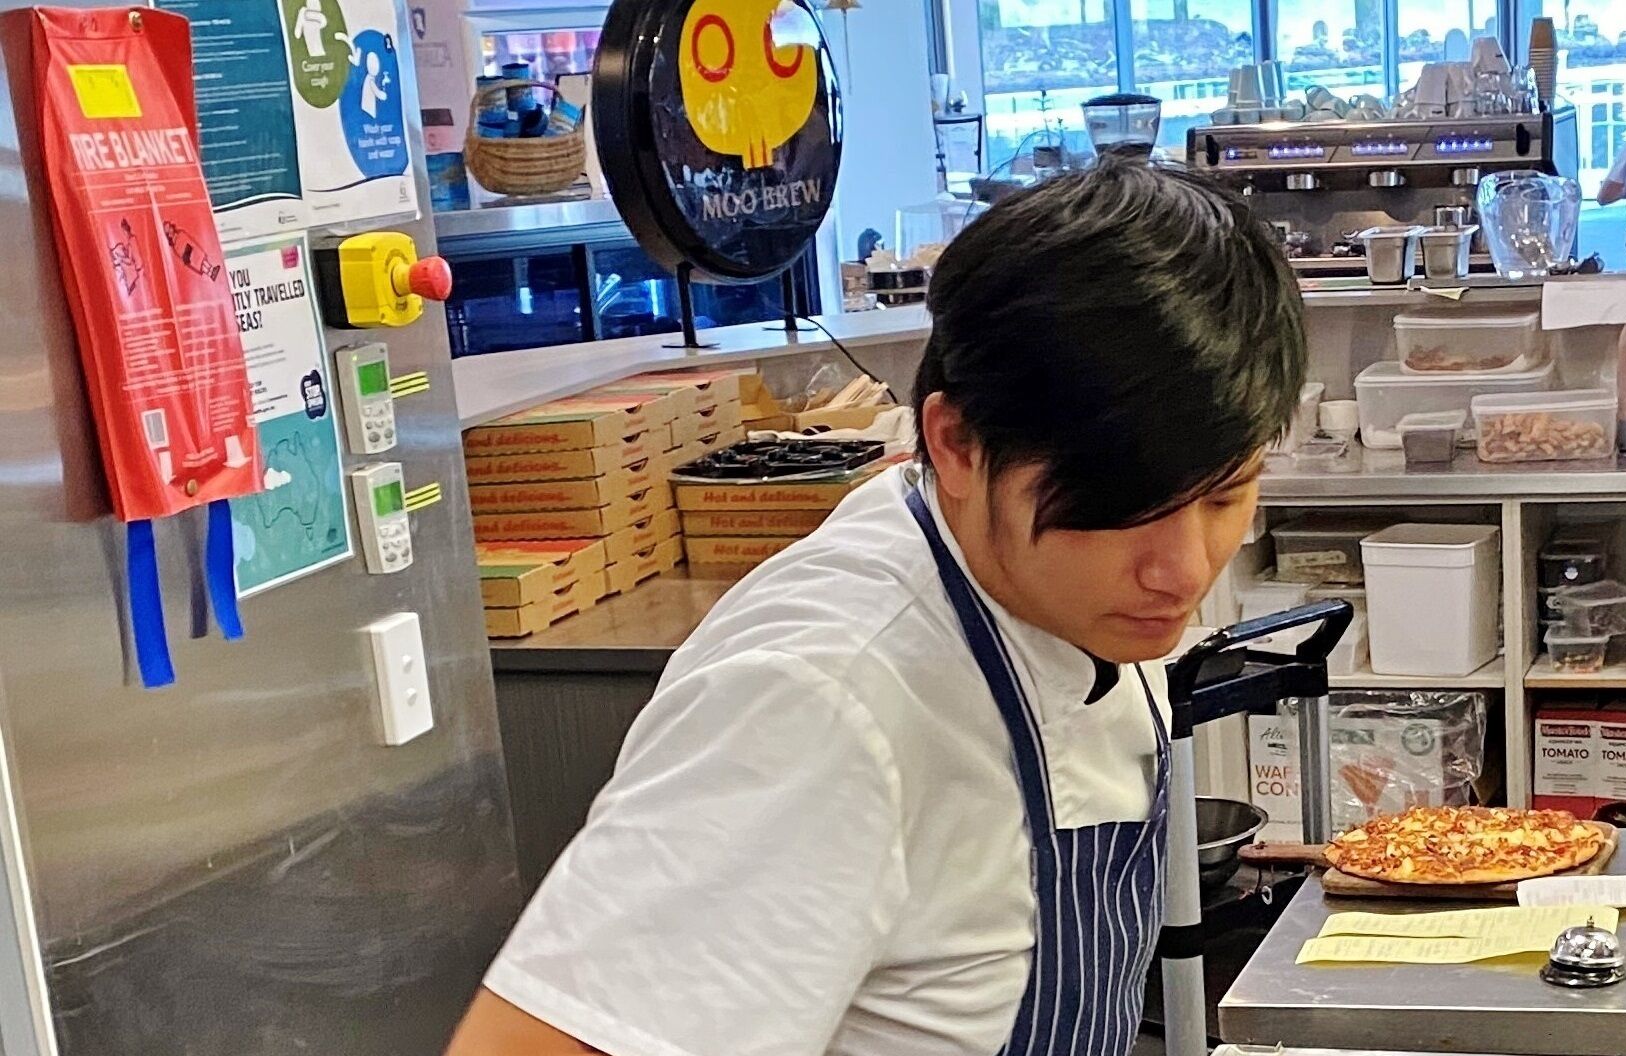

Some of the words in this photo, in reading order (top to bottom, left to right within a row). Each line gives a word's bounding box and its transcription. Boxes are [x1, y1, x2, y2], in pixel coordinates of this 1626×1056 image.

[108, 127, 194, 168] BLANKET
[703, 189, 757, 221] MOO
[763, 179, 821, 210] BREW
[229, 268, 250, 289] YOU
[254, 279, 305, 307] TRAVELLED
[703, 491, 727, 504] Hot
[730, 490, 756, 503] and
[710, 516, 735, 529] Hot
[714, 544, 739, 556] Hot
[1542, 748, 1589, 759] TOMATO
